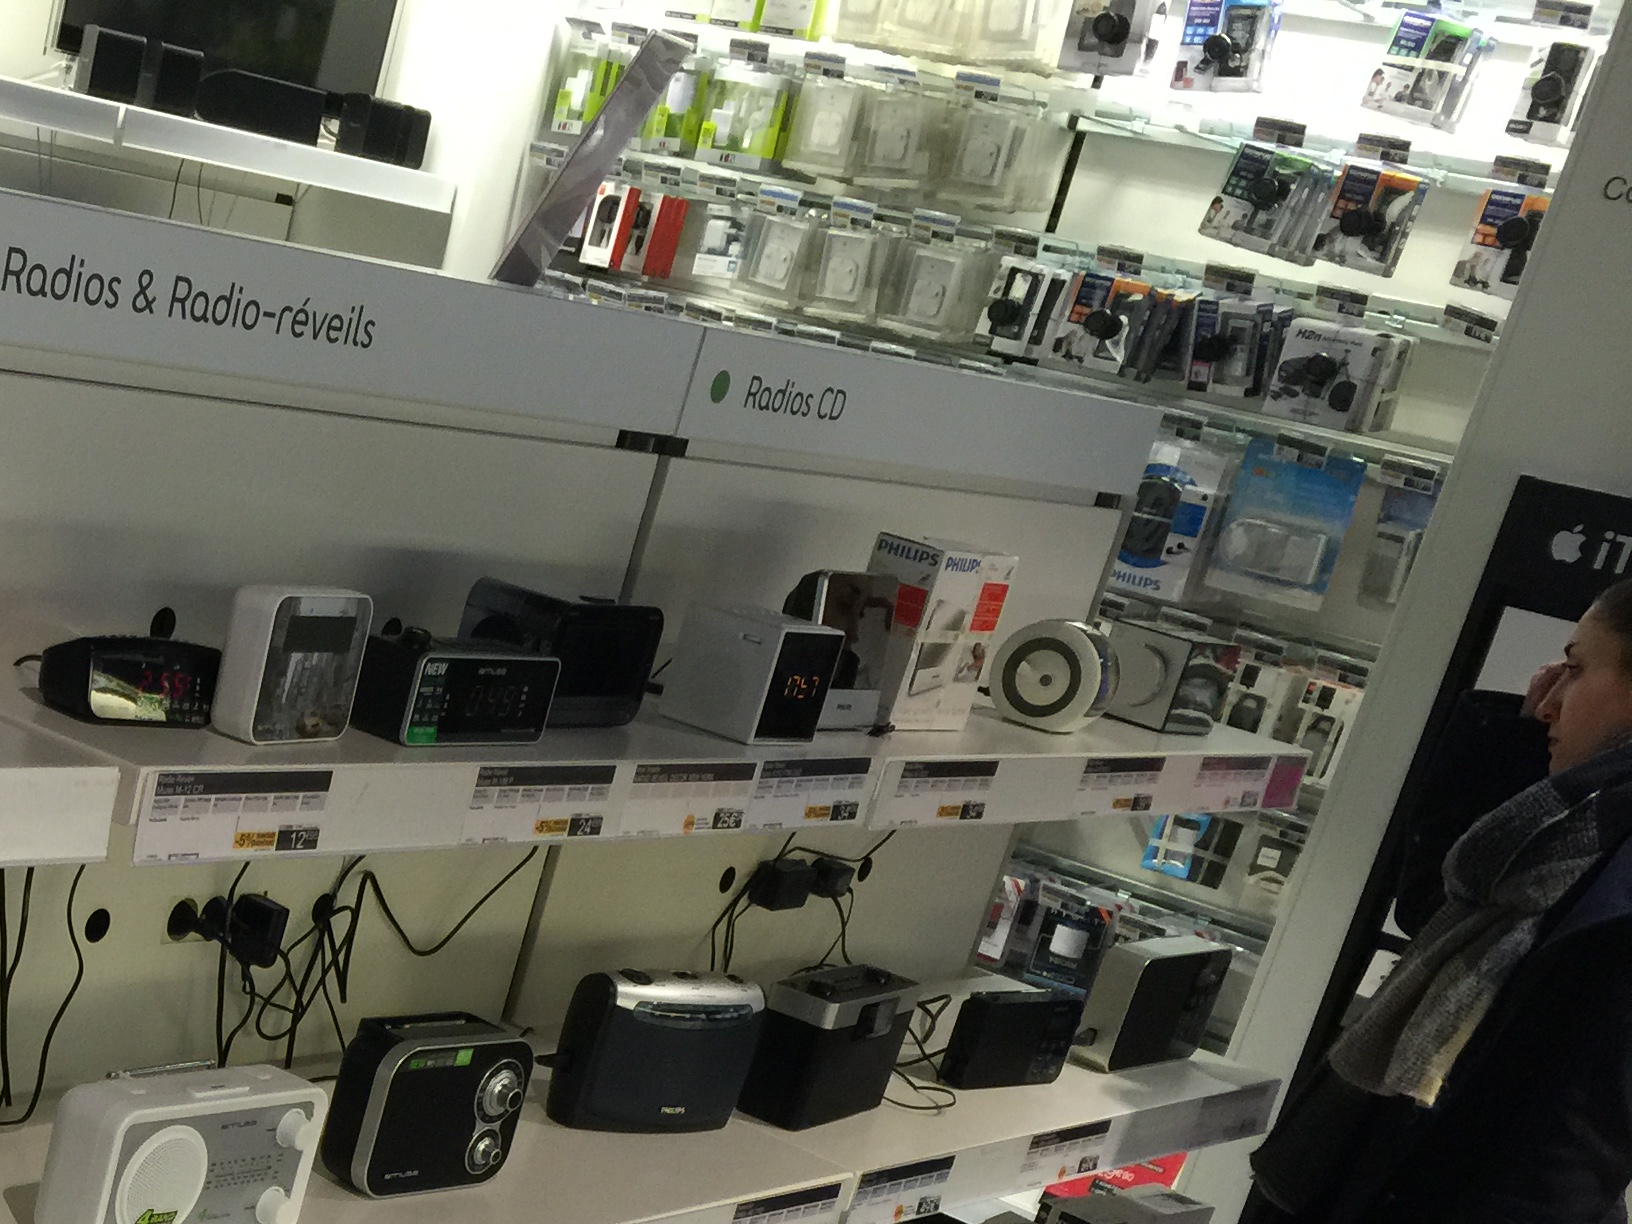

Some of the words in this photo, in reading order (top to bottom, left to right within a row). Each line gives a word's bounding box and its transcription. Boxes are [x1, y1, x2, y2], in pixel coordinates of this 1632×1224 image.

[1, 246, 121, 308] Radios
[132, 269, 156, 315] &
[168, 275, 376, 349] Radio-réveils
[1295, 329, 1322, 341] H2n
[744, 375, 813, 417] Radios
[817, 386, 846, 420] CD
[877, 538, 939, 567] PHILIPS
[425, 662, 448, 675] NEW
